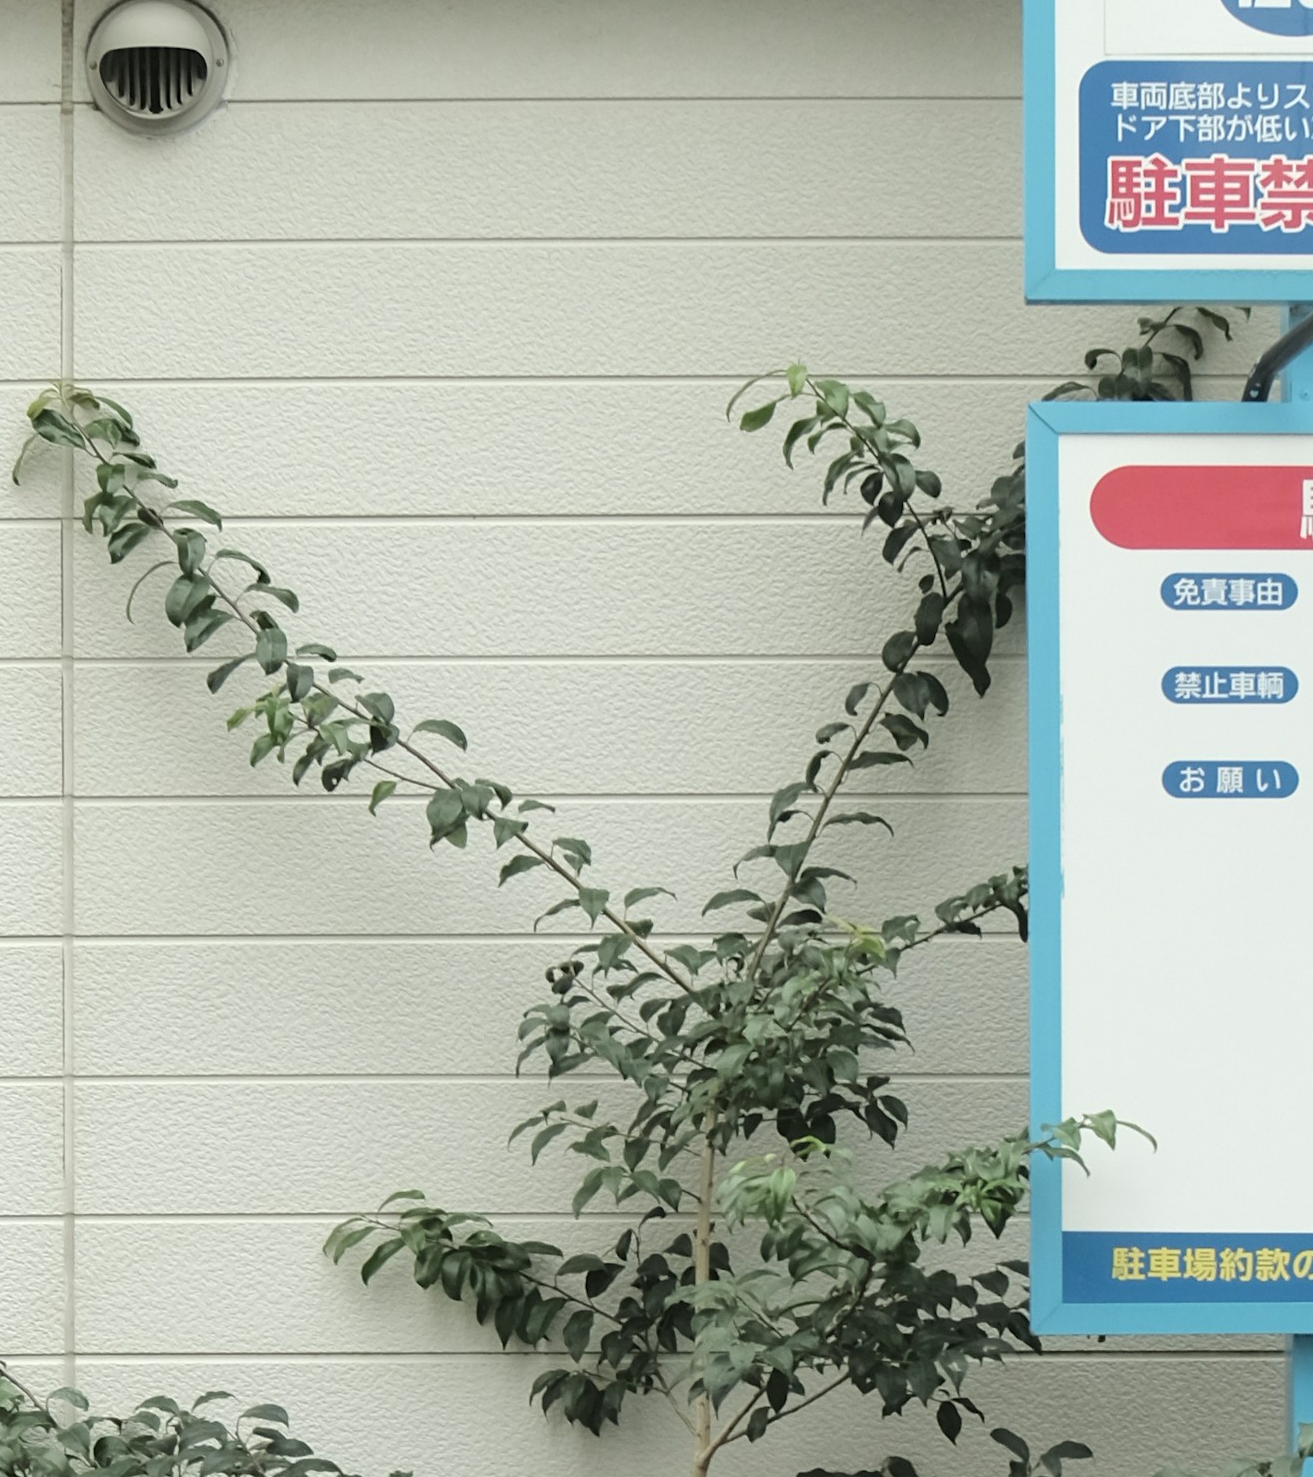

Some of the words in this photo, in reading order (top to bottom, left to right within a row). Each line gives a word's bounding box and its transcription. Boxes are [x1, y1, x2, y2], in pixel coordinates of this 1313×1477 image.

[1173, 578, 1284, 606] 免責事由
[1174, 671, 1284, 700] 禁止車輌
[1180, 767, 1280, 793] お願い
